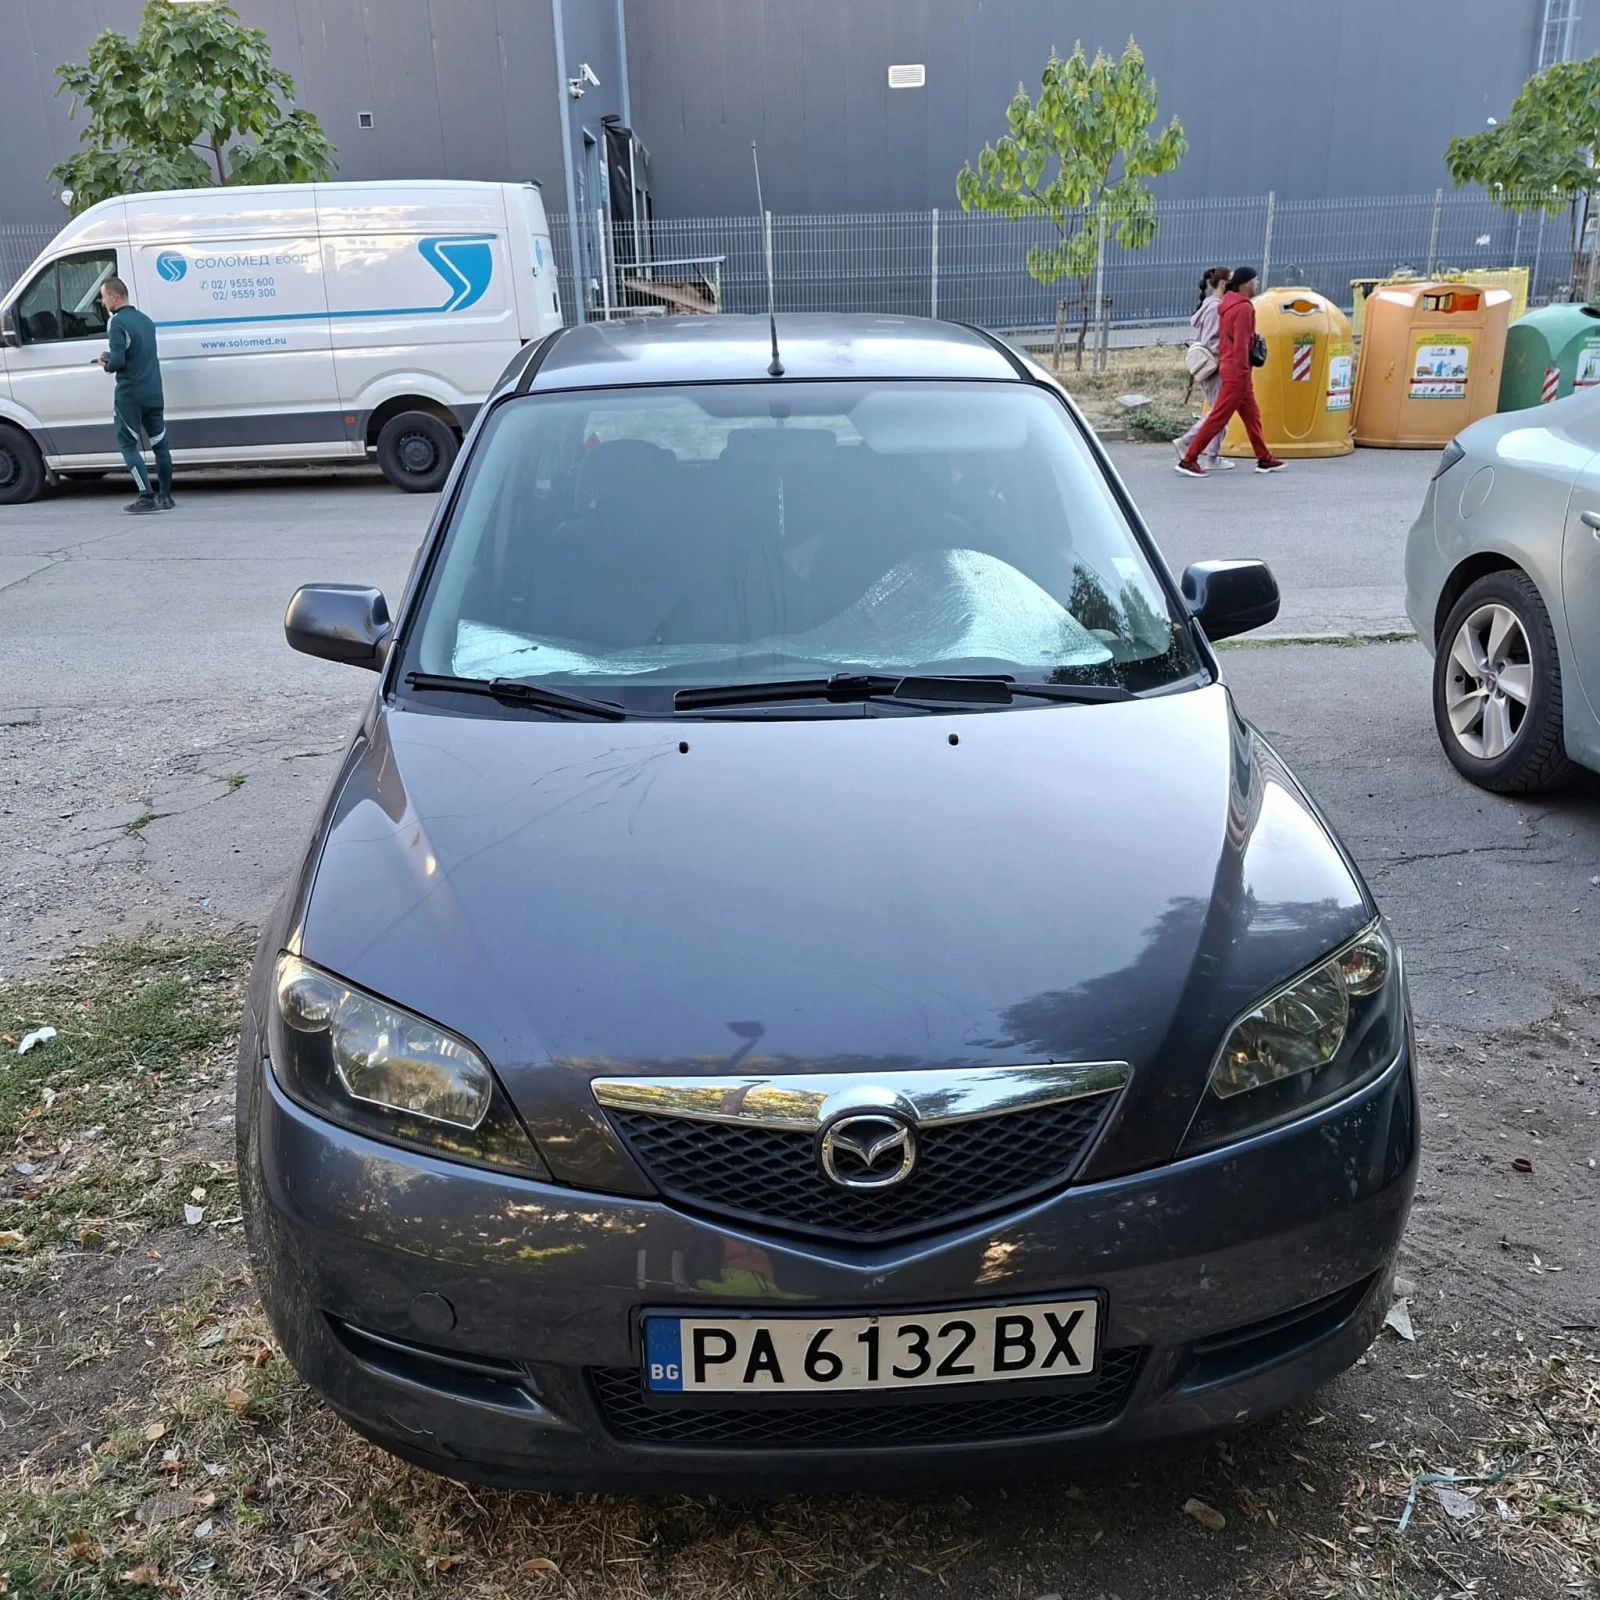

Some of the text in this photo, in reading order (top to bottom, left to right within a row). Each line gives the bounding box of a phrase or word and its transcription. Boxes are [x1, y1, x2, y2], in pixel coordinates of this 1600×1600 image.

[195, 254, 309, 269] СОЛОМЕД ЕООД
[211, 277, 275, 290] 02/ 9555 600
[212, 288, 276, 300] 02/ 9559 300
[201, 337, 287, 349] www.solomed.eu
[803, 1319, 977, 1382] 6132
[651, 1363, 680, 1380] BG
